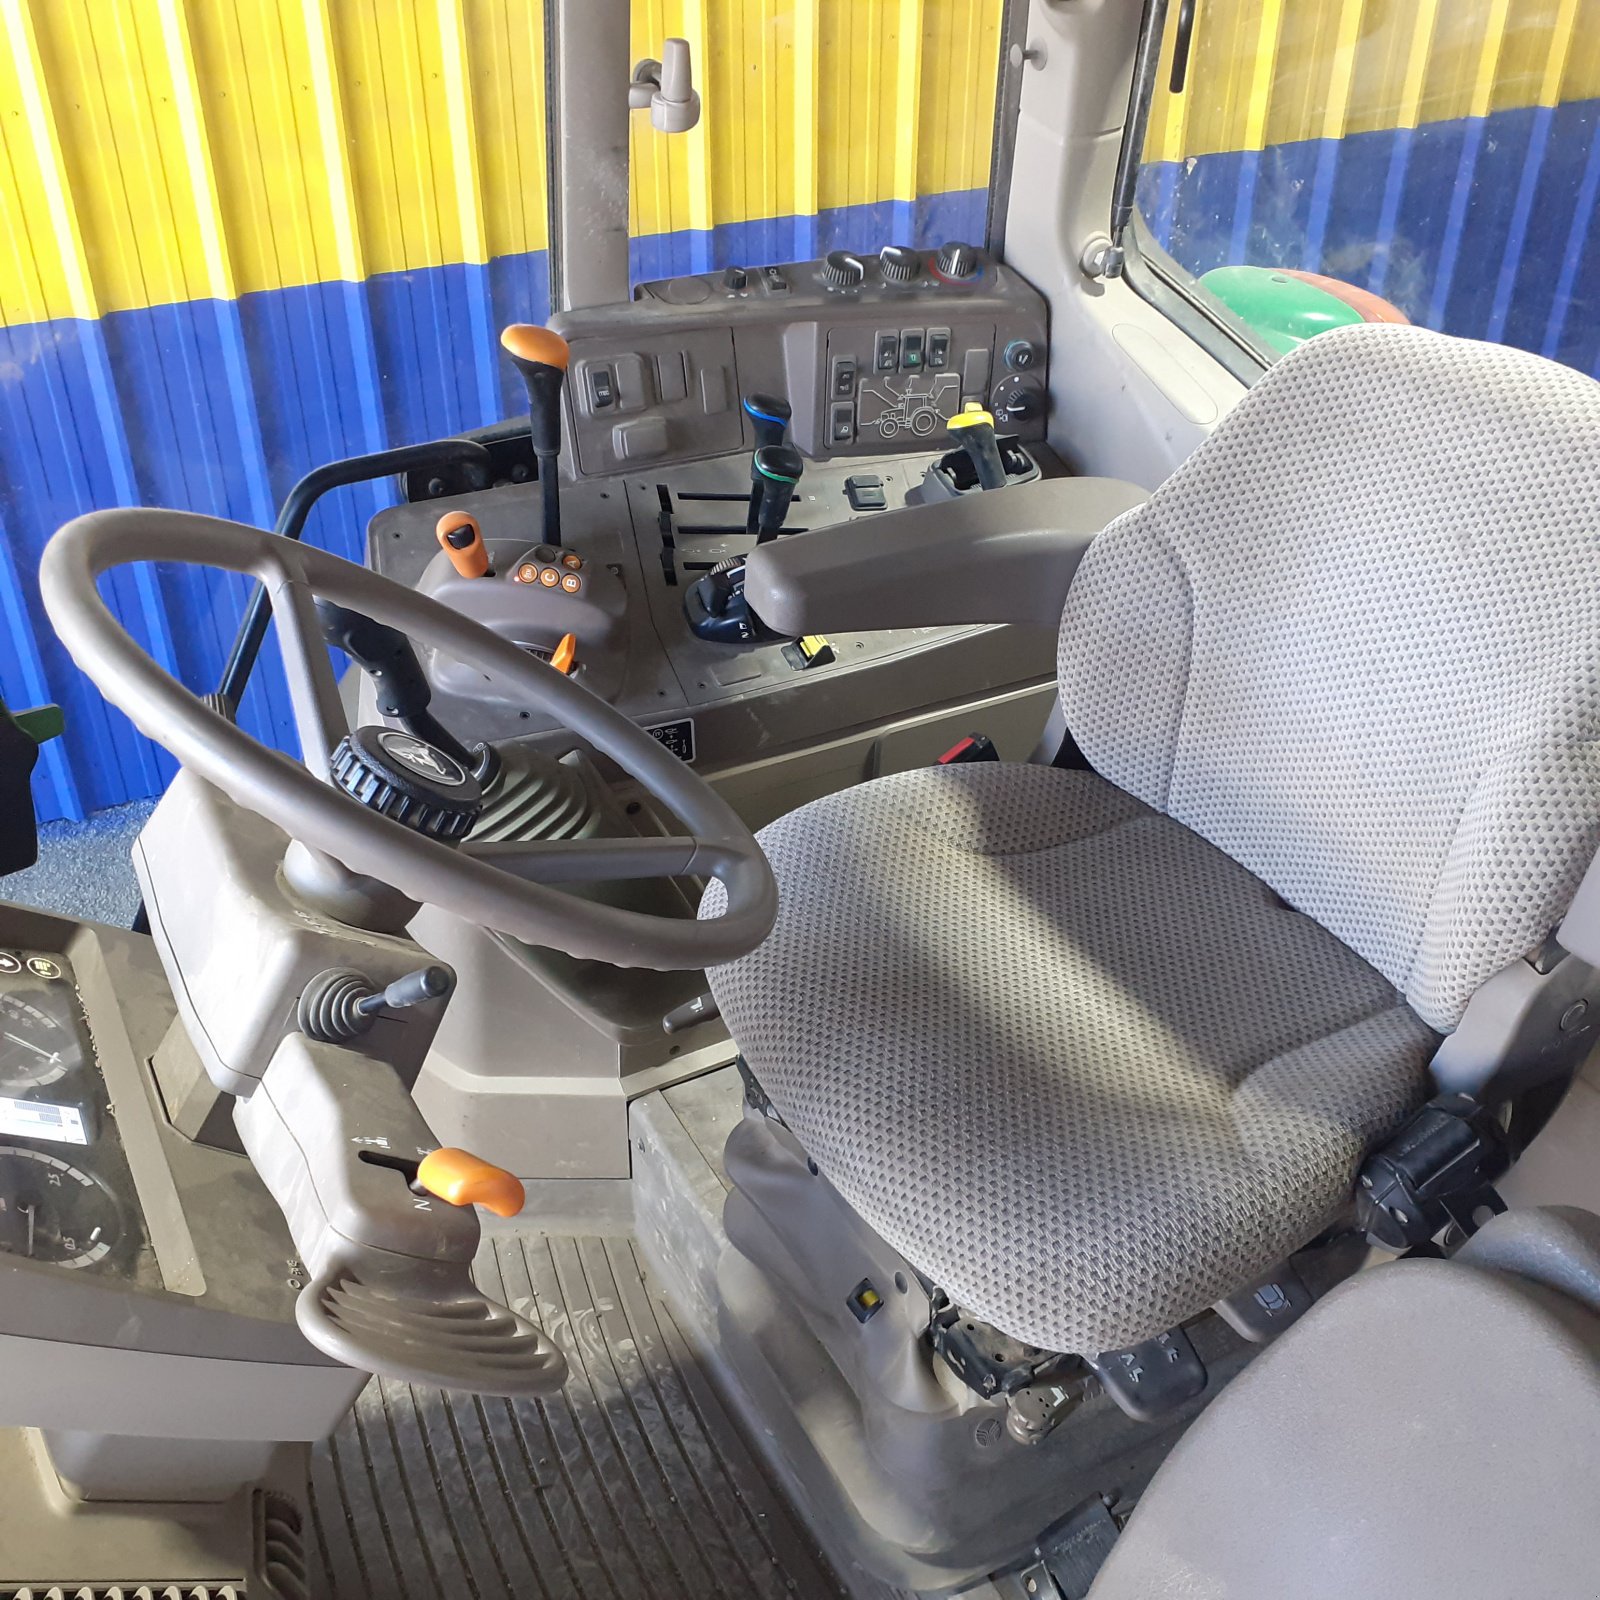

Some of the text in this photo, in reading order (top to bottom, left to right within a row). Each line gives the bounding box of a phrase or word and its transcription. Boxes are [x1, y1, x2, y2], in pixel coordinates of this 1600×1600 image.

[567, 560, 577, 569] A
[544, 572, 555, 582] C
[566, 578, 577, 588] B
[413, 1198, 432, 1211] N
